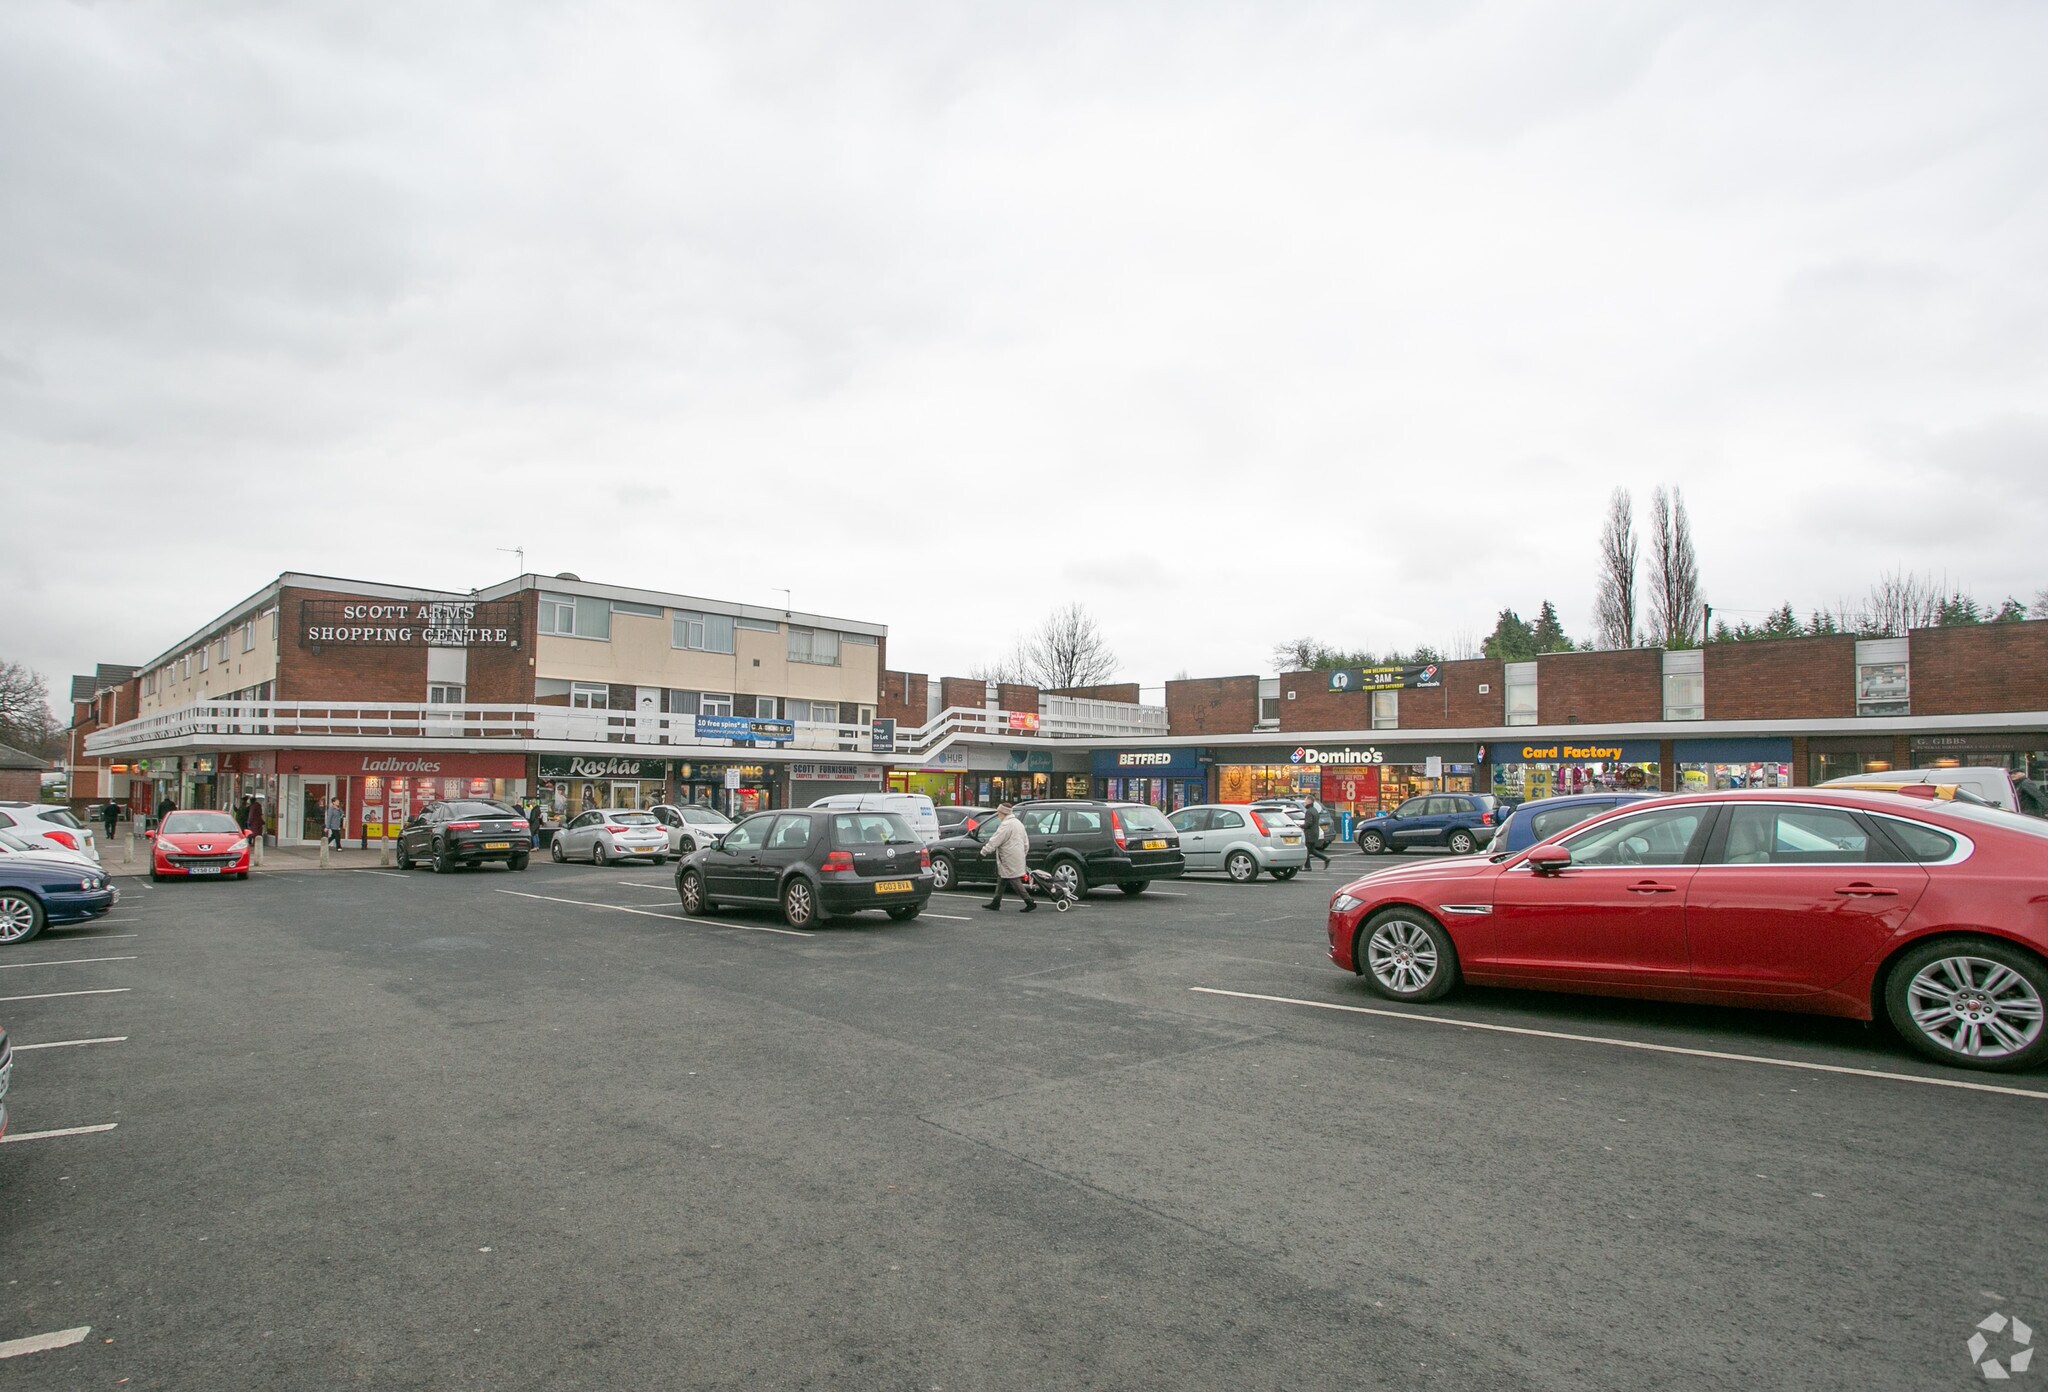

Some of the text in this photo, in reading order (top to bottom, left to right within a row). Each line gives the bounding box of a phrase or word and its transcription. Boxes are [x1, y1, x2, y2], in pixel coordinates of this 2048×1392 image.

[344, 605, 475, 619] SCOTT ARMS
[309, 627, 508, 642] SHOPPING CENTRE
[1374, 674, 1392, 683] 3AM
[946, 753, 963, 762] HUB
[1305, 747, 1384, 763] Domino's
[1522, 746, 1622, 760] Card Factory
[223, 754, 232, 768] L
[361, 756, 440, 772] Ladbrokes
[1119, 753, 1171, 765] BETFRED
[793, 764, 857, 774] SCOTT FURNISHING
[365, 778, 382, 788] BEST
[1302, 775, 1317, 783] FREE
[1531, 773, 1545, 784] 10
[1341, 781, 1356, 800] £8
[1531, 787, 1545, 798] £1
[879, 882, 910, 891] FG03 BVA
